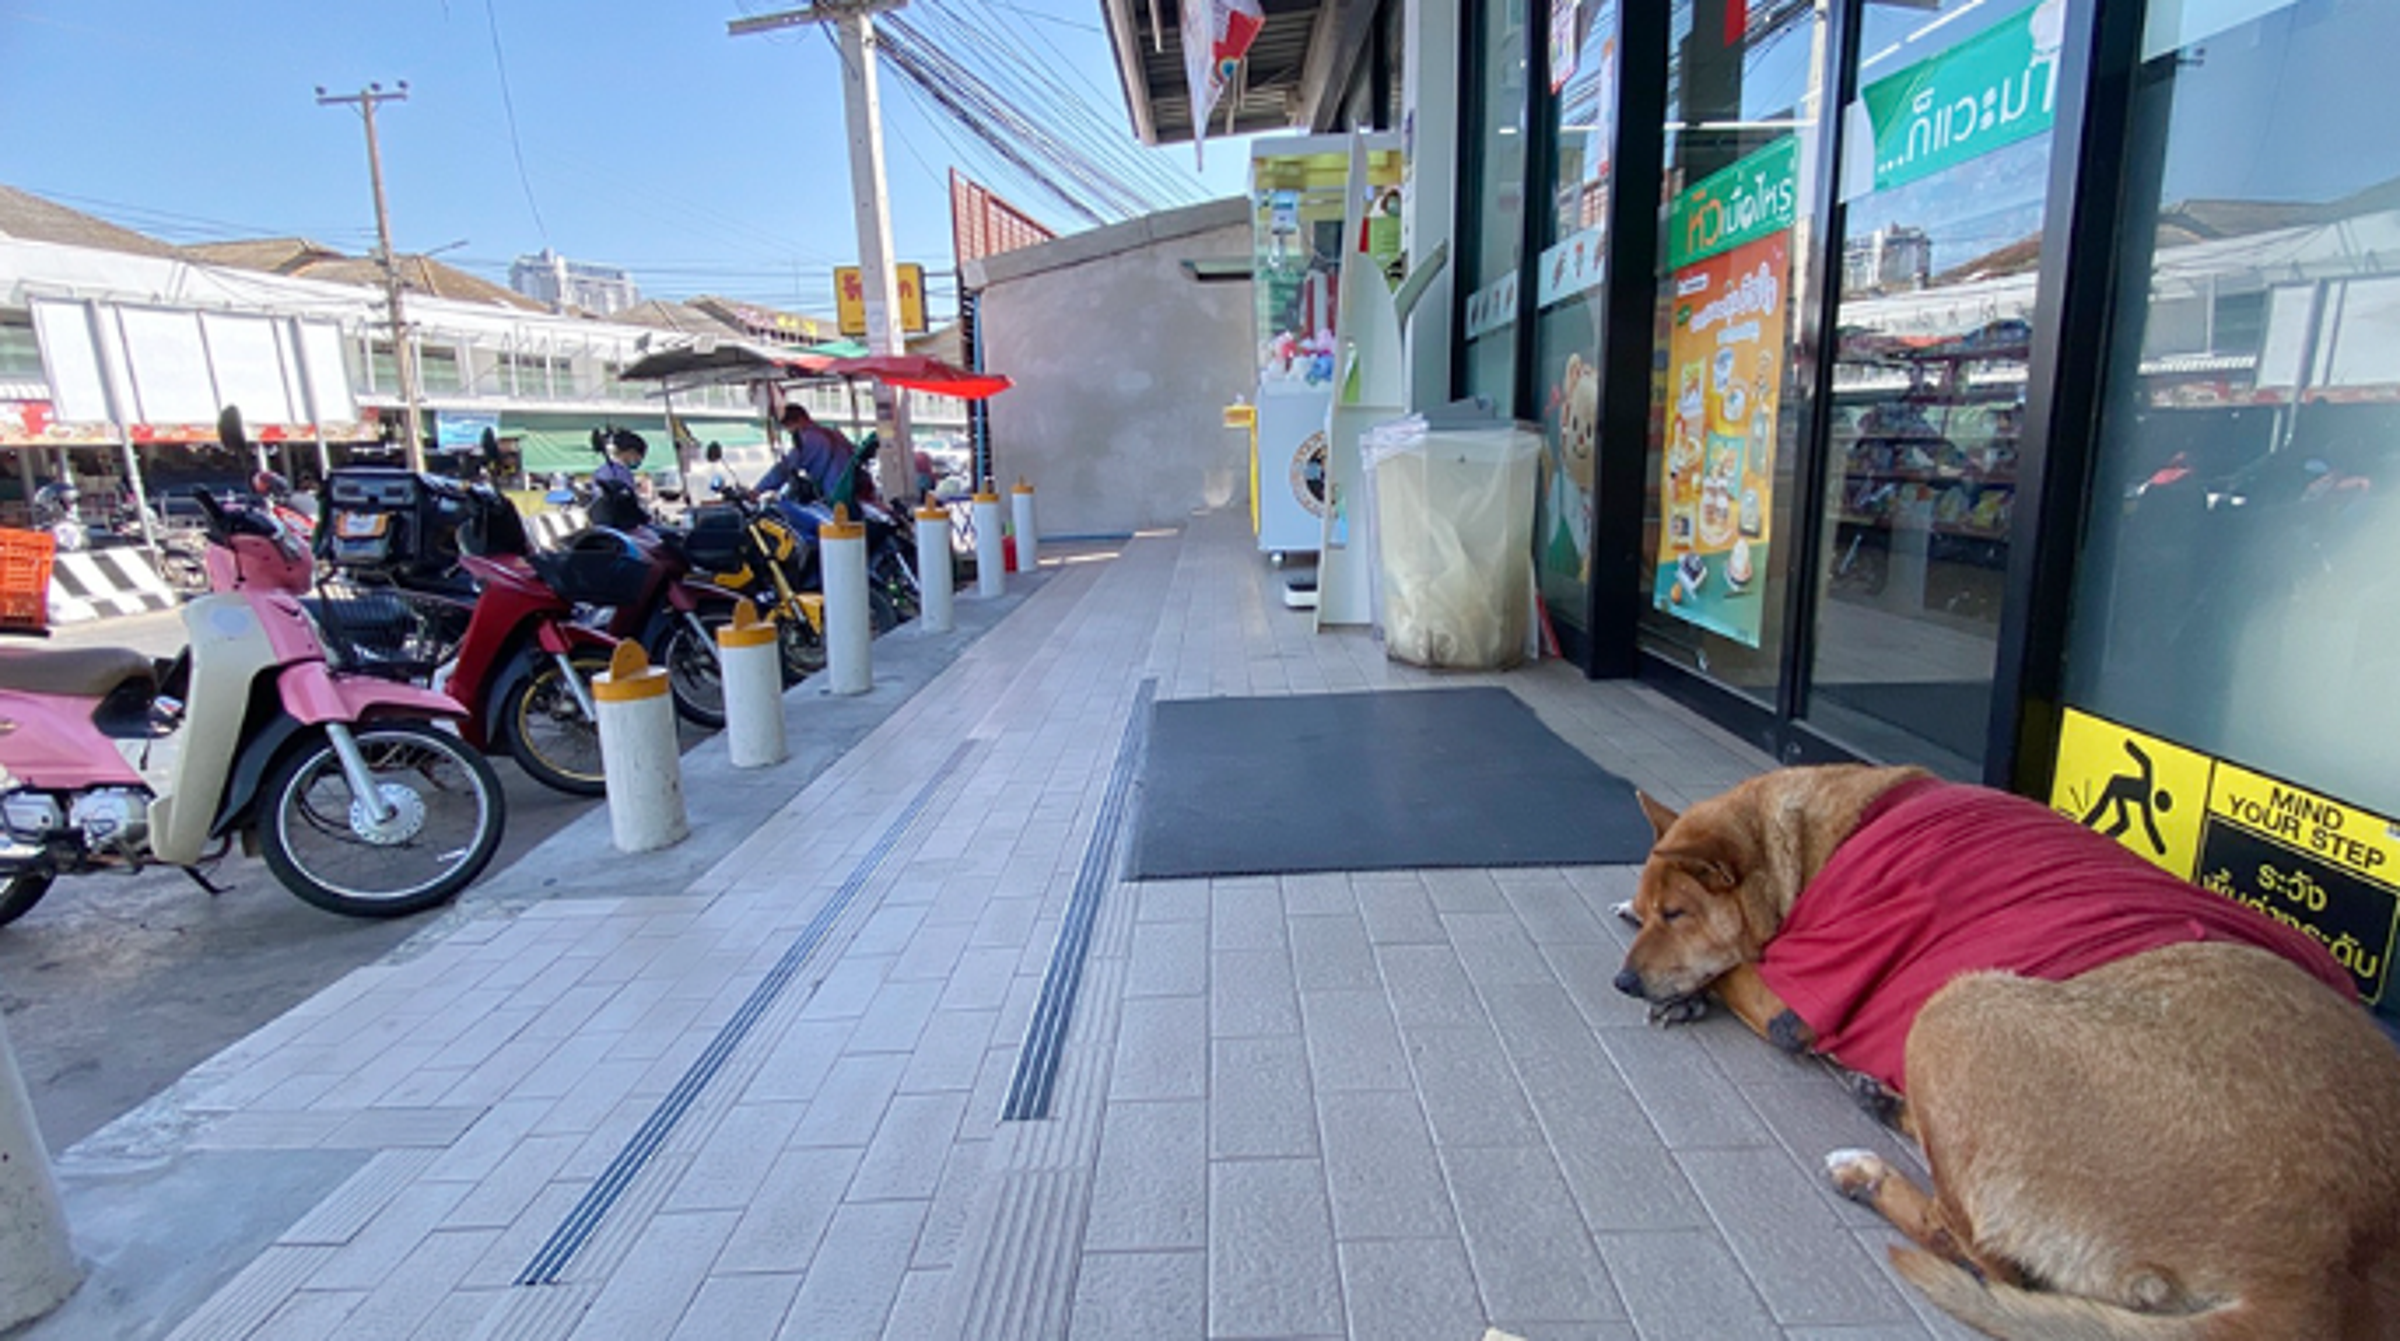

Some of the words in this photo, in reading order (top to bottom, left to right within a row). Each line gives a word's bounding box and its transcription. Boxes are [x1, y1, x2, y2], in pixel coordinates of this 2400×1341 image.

[2229, 794, 2301, 840] YOUR
[2310, 827, 2386, 869] STEP
[2270, 787, 2344, 830] MIND
[2257, 864, 2328, 911] ระวัง
